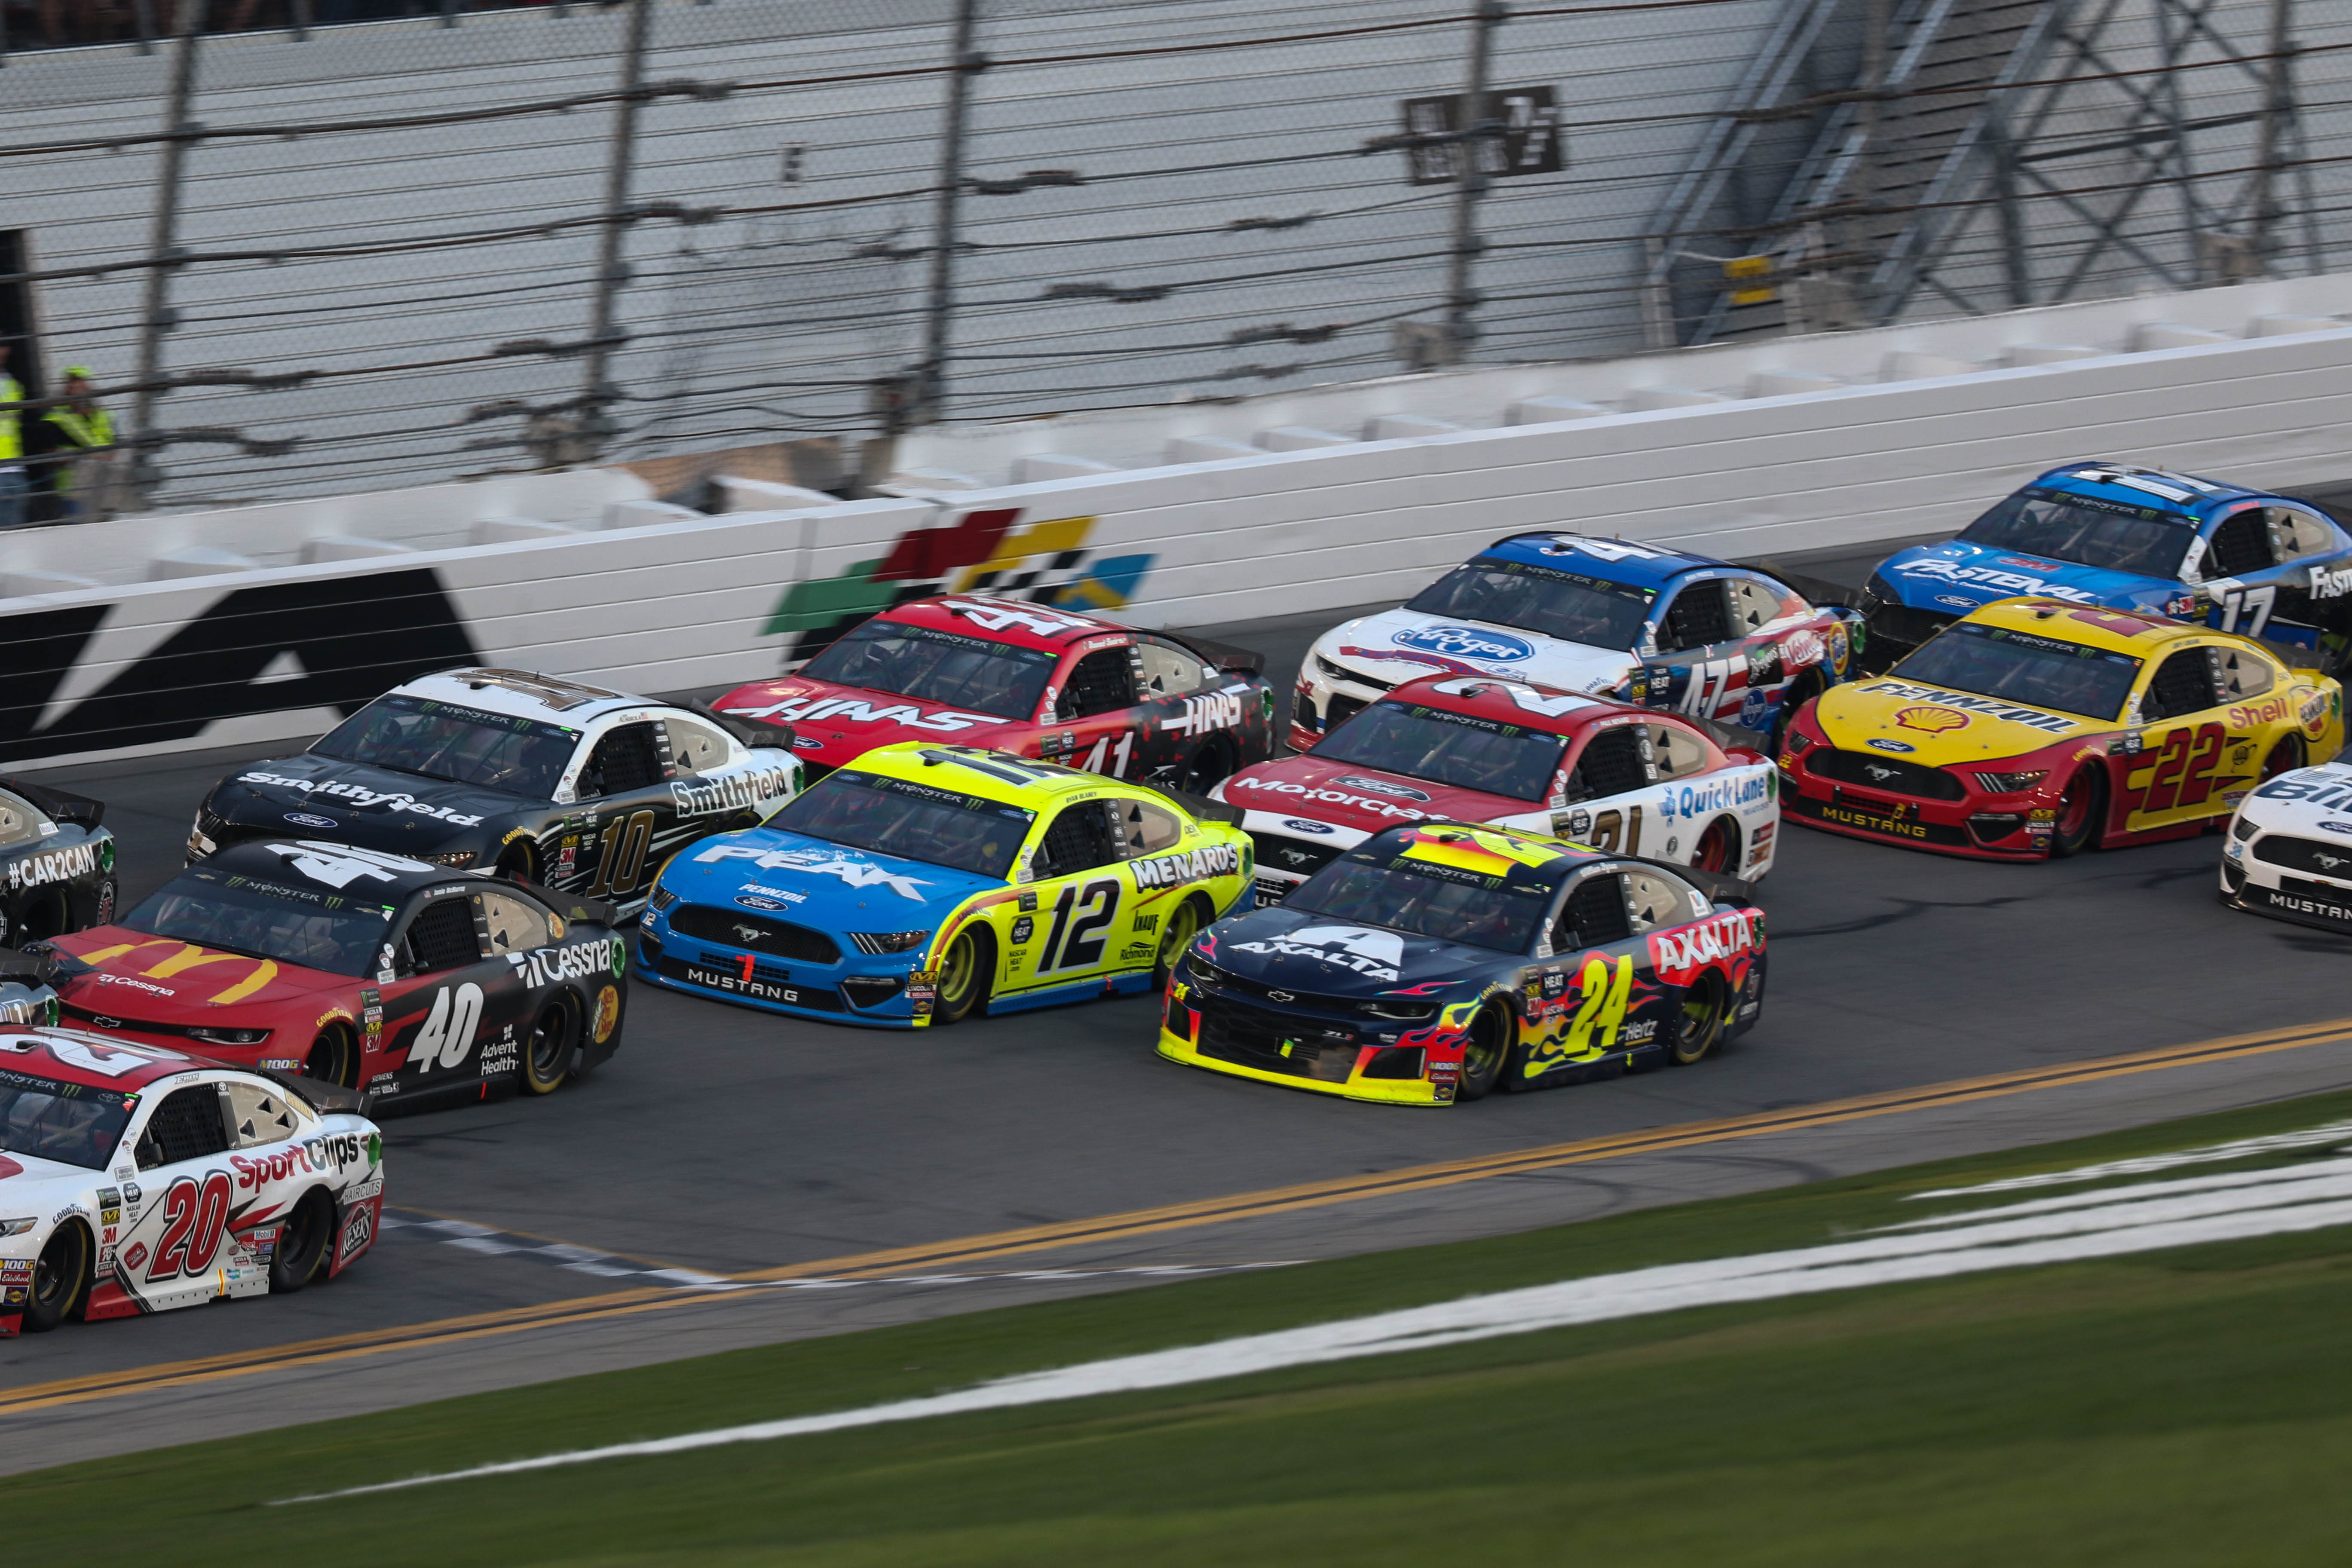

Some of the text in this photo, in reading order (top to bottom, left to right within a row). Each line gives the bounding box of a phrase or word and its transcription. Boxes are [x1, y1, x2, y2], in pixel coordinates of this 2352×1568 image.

[1998, 557, 2064, 572] 3M
[1893, 558, 2097, 605] FASTENAL
[2220, 585, 2276, 638] 17
[922, 630, 989, 649] MONSTER
[1408, 625, 1523, 658] Kroger
[440, 705, 510, 725] MONSTER
[721, 697, 1014, 732] HAAS
[1161, 683, 1252, 738] HAAS
[1853, 682, 2082, 734] PENNZOIL
[2228, 698, 2289, 730] Shell
[1430, 710, 1498, 730] MONSTER
[1874, 739, 1909, 751] Ford
[2142, 720, 2226, 814] 22
[670, 765, 789, 818] Smithfield
[893, 782, 962, 803] MONSTER
[1066, 791, 1097, 803] RYAN BLANEY
[1344, 778, 1416, 797] Ford
[1680, 779, 1733, 819] Quick
[1734, 776, 1765, 805] Lane
[237, 772, 485, 828] Smithfield
[1234, 777, 1458, 822] Motorcra
[291, 814, 329, 826] Ford
[1292, 820, 1328, 833] Ford
[1823, 806, 1926, 838] MUSTANG
[263, 839, 436, 889] 40
[560, 848, 575, 864] 3M
[585, 809, 655, 899] 10
[8, 844, 96, 889] #CAR2CAN
[692, 845, 937, 903] PEAK
[1128, 842, 1239, 894] MENARDS
[1409, 862, 1480, 883] MONSTER
[247, 881, 320, 902] MONSTER
[738, 883, 808, 903] PENNZOIL
[742, 897, 781, 910] Ford
[2269, 892, 2352, 921] MUSTAN
[642, 912, 656, 927] 12
[1035, 876, 1122, 977] 12
[1120, 948, 1155, 961] Richmond
[1657, 913, 1753, 975] AXALTA
[535, 939, 611, 981] Cessna
[1228, 941, 1399, 982] AXALTA
[114, 977, 175, 996] Cessna
[687, 968, 798, 1002] MUSTANG
[1544, 974, 1564, 988] HEAT
[365, 1007, 379, 1016] LINCOLN
[1563, 954, 1633, 1056] 24
[316, 1007, 354, 1028] GOODYEAR
[406, 982, 484, 1074] 40
[1625, 1019, 1658, 1041] Hertz
[367, 1035, 381, 1052] 3M
[480, 1039, 518, 1060] Advent
[259, 1059, 300, 1070] MOOG
[481, 1056, 519, 1076] Health
[126, 1188, 138, 1198] HEAT
[344, 1182, 380, 1202] HAIRCUTS
[52, 1203, 90, 1225] GOODYEAR
[126, 1204, 141, 1212] NASCAR
[102, 1226, 117, 1244] 3M
[147, 1171, 231, 1283] 20
[256, 1230, 271, 1239] Mobil
[2, 1273, 30, 1283] Edelbrock
